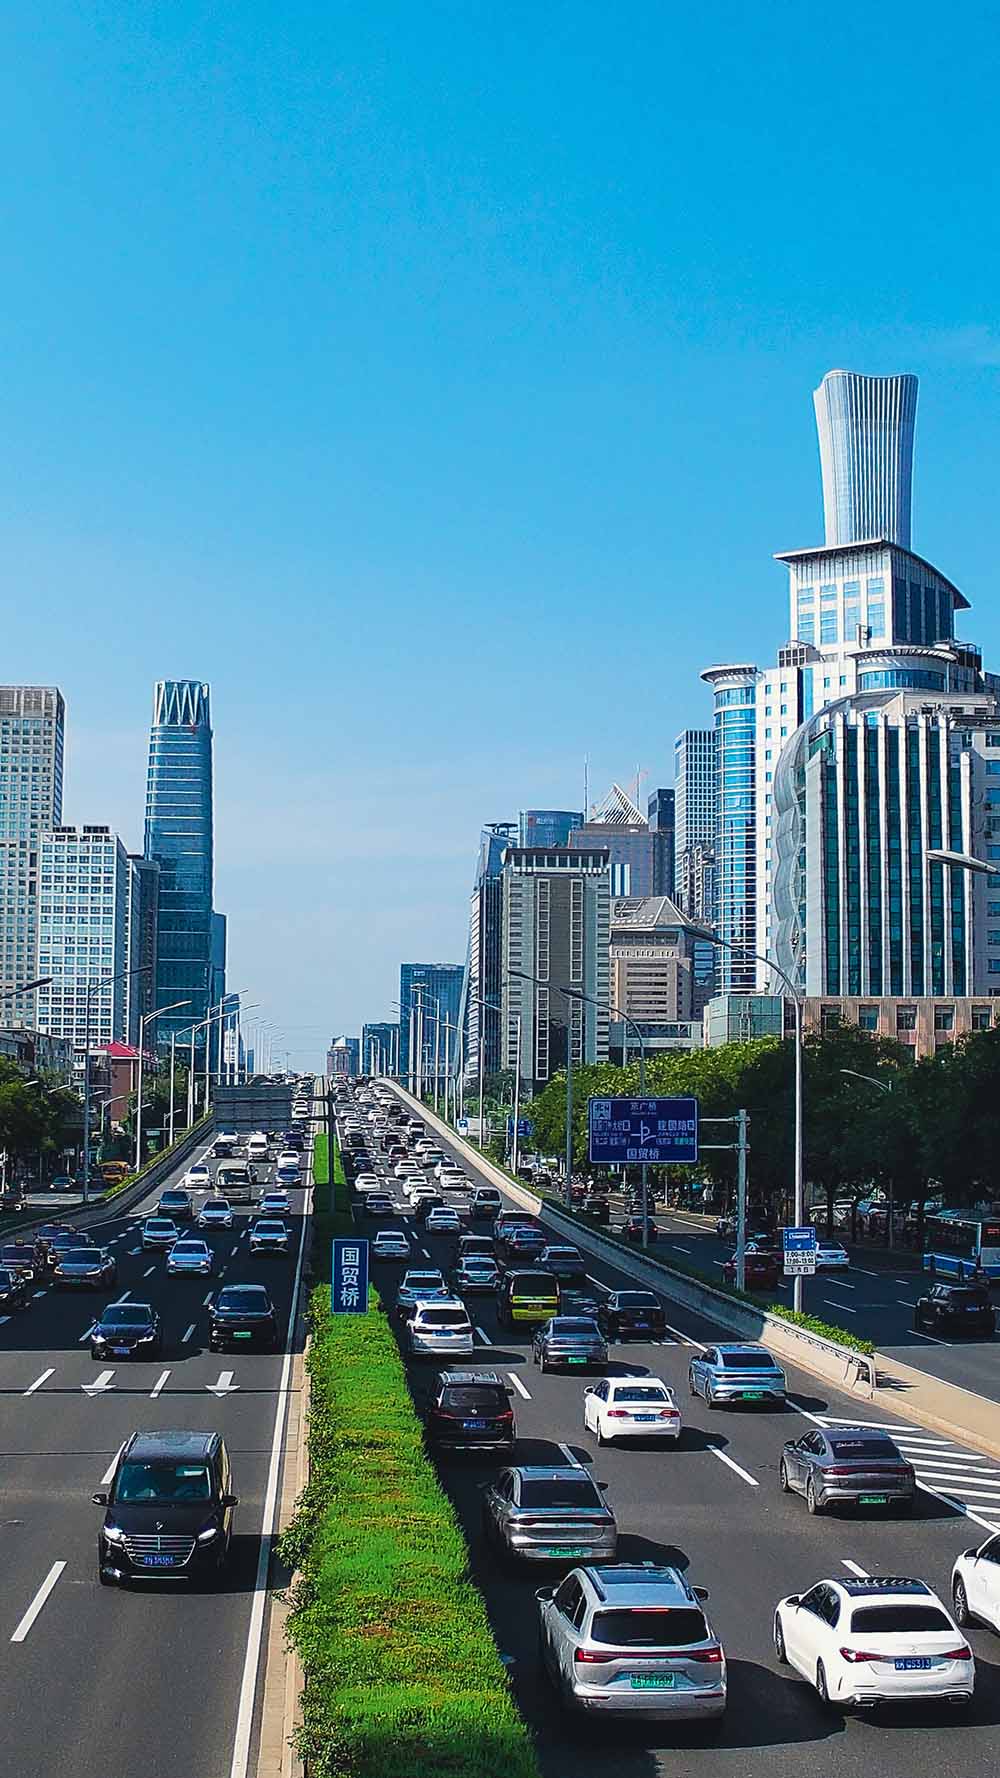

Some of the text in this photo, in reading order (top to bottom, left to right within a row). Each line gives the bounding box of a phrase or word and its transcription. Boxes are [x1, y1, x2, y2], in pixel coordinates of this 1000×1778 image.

[626, 1148, 661, 1160] 国贸桥
[340, 1247, 360, 1307] 国贸桥
